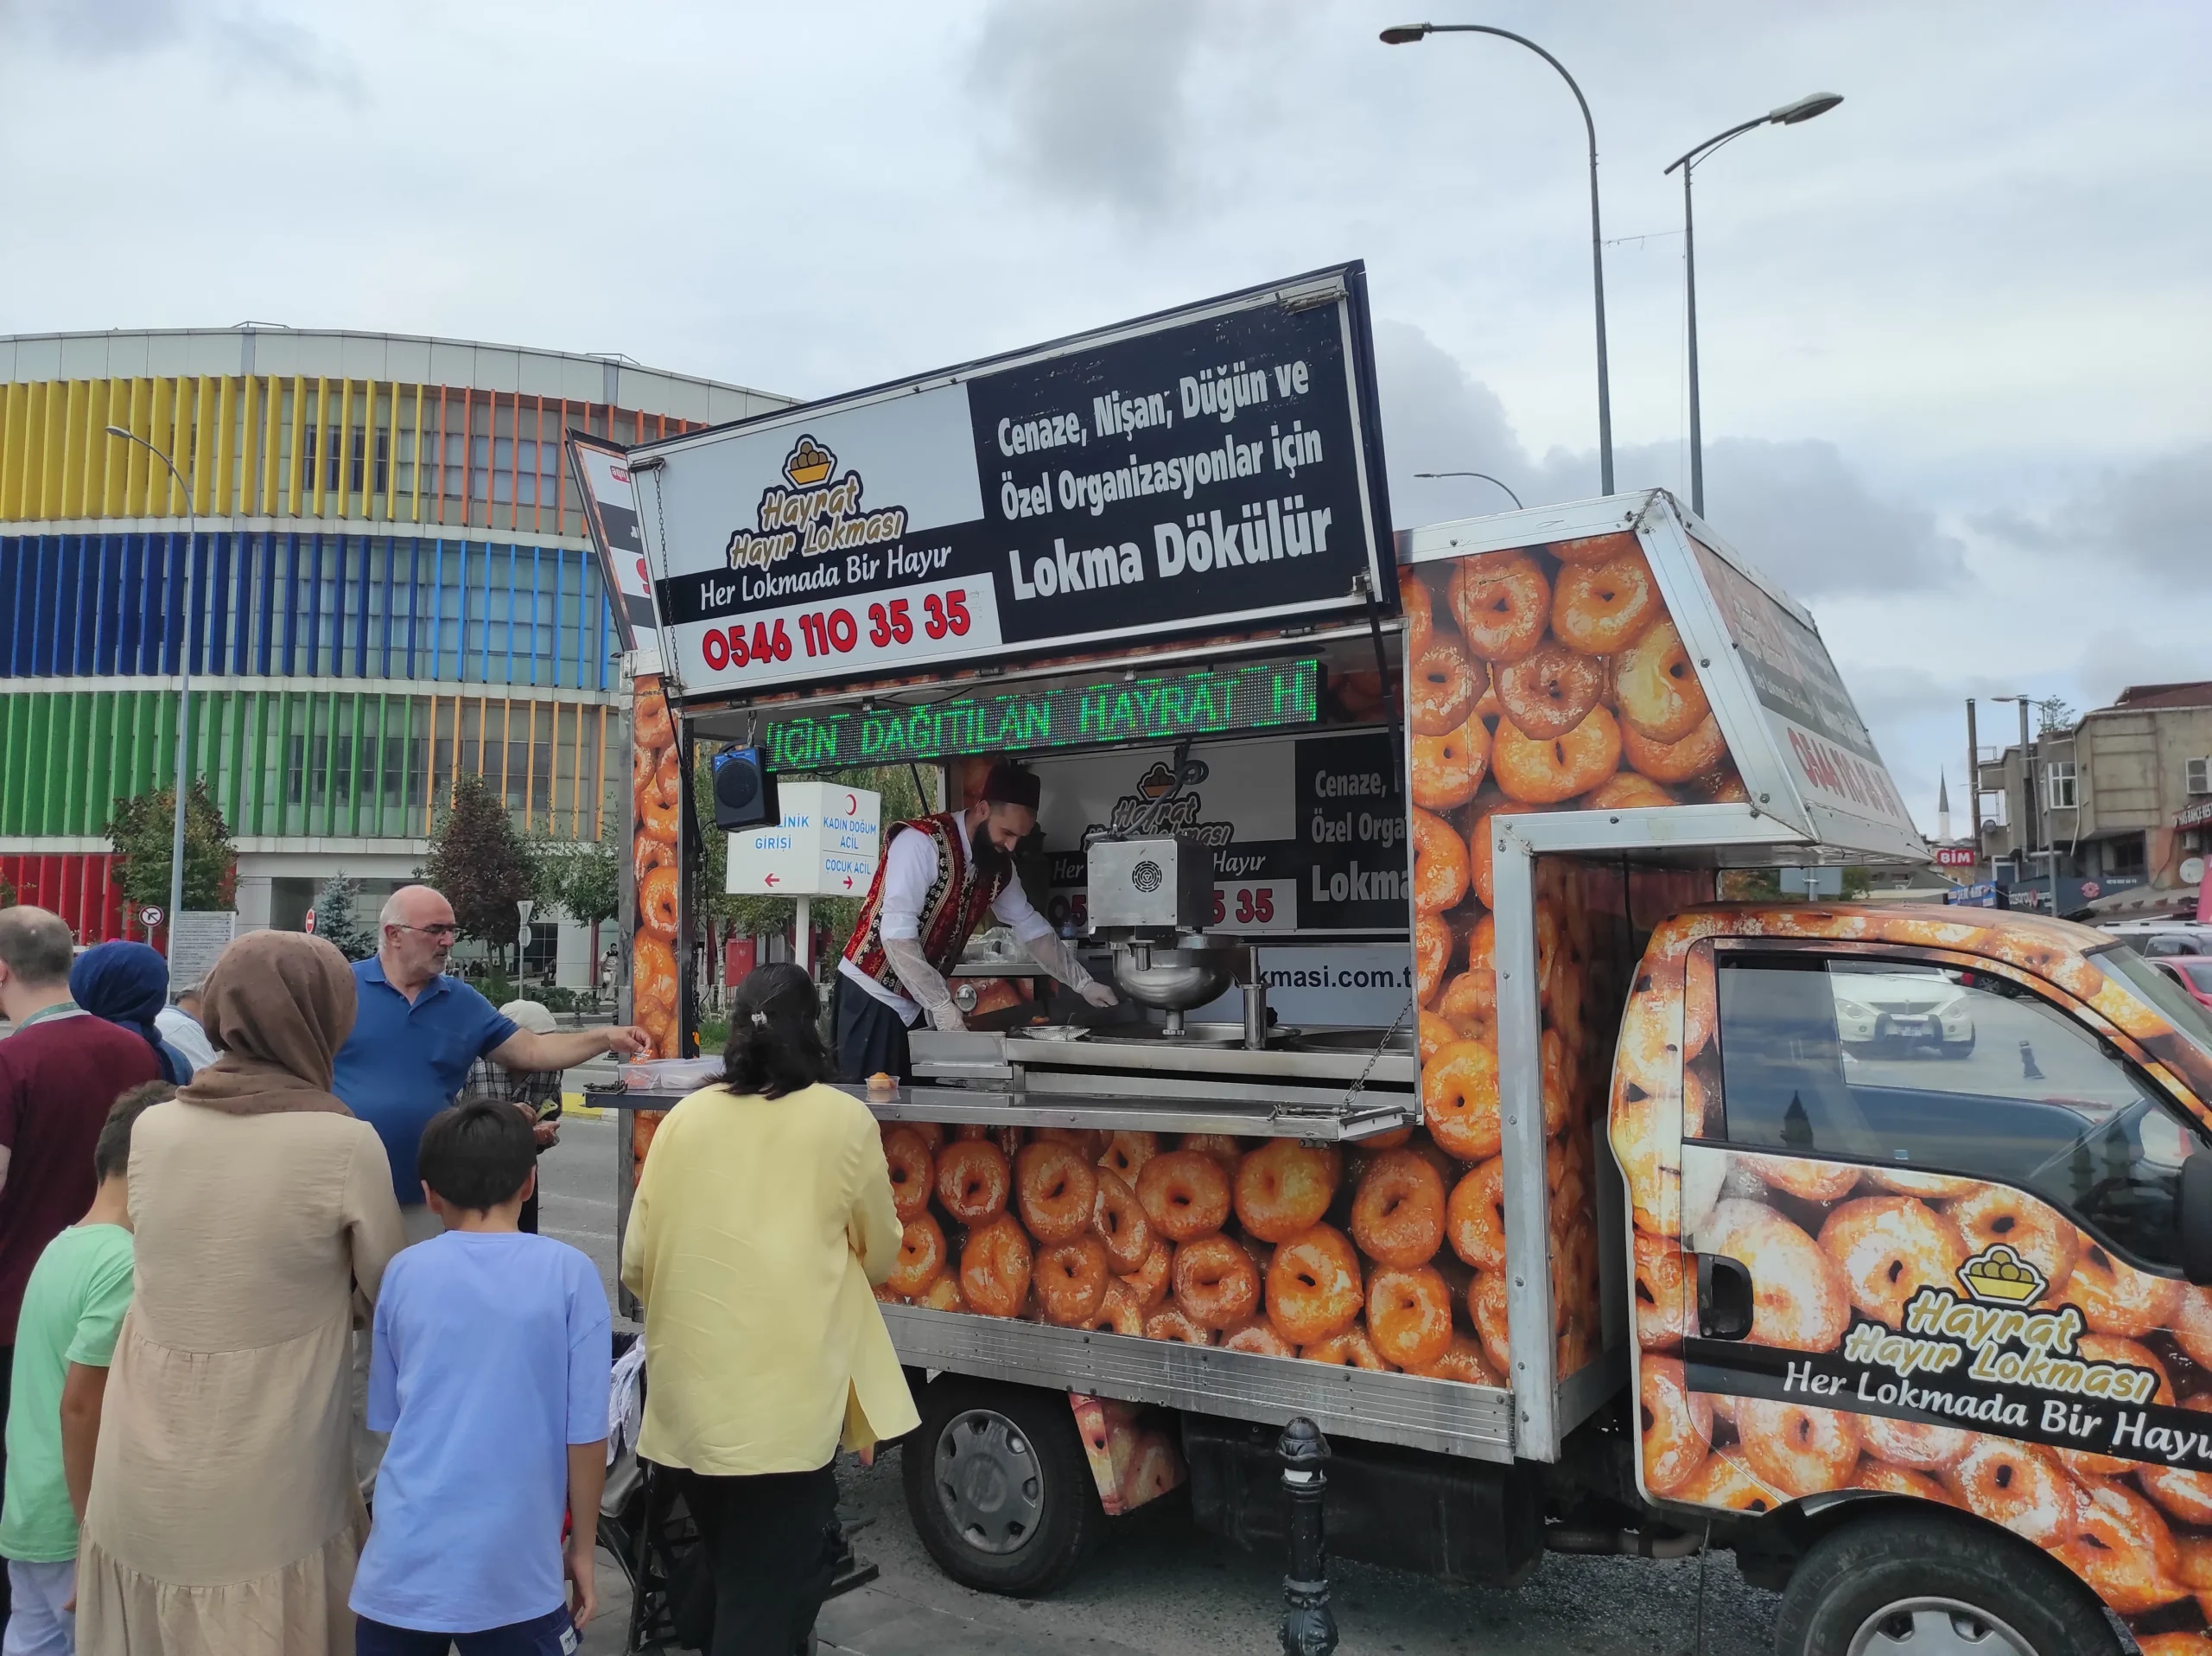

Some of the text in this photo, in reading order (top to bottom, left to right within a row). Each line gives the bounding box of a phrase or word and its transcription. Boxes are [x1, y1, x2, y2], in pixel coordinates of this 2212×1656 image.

[997, 360, 1310, 457] Cenaze, Nişan, Düğün ve
[1000, 419, 1324, 520] Özel Organizasyonlar için
[761, 475, 858, 532] Hayrat
[729, 510, 904, 571] Hayır Lokması
[1008, 494, 1332, 601] Lokma Dökülür
[700, 544, 952, 611] Her Lokmada Bir Hayır
[702, 589, 971, 672] 0546 110 35 35
[1080, 679, 1241, 733] HAYRAT
[1314, 769, 1387, 799] Cenaze,
[754, 834, 792, 852] GİRİŞİ
[823, 816, 877, 836] KADIN DOĞUM
[840, 834, 859, 850] ACİL
[1311, 807, 1408, 849] Özel Orga
[824, 858, 872, 875] ÇOCUK ACİL
[1053, 850, 1267, 881] Her Hayır
[1940, 850, 1971, 863] BİM
[1214, 889, 1226, 924] 5
[1236, 888, 1274, 924] 35
[1906, 1289, 2081, 1355] Hayrat
[1844, 1322, 2155, 1404] Hayır Lokması
[1783, 1360, 2212, 1461] Her Lokmada Bir Hayı
